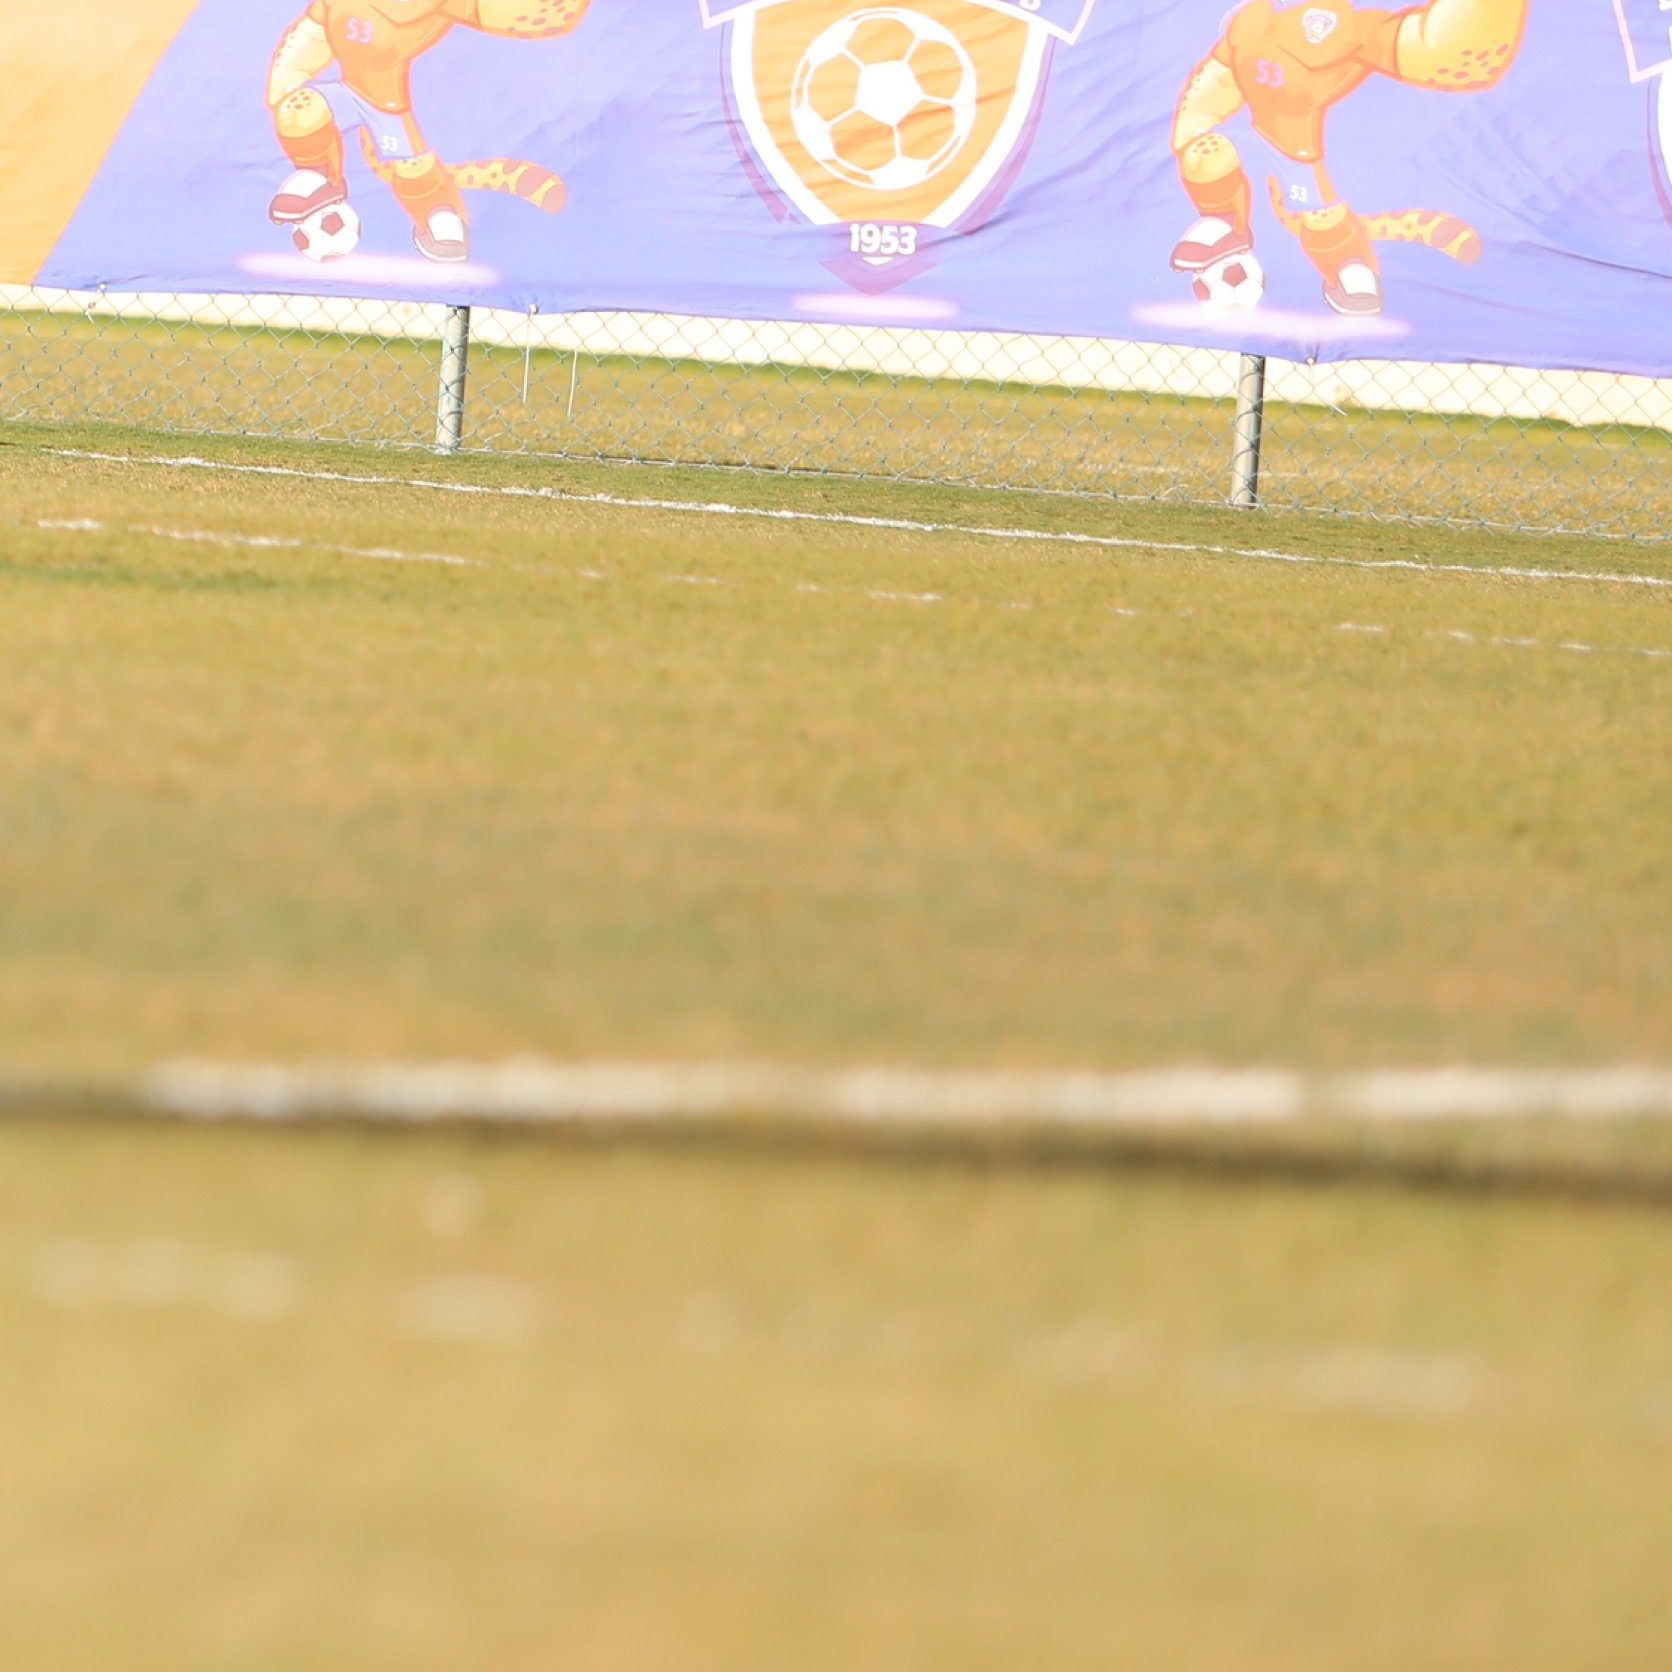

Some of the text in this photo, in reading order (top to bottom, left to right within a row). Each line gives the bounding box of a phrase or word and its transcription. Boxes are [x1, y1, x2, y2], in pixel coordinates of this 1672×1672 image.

[346, 18, 372, 44] 53
[1255, 59, 1284, 87] 53
[382, 136, 398, 151] 53
[1290, 185, 1307, 202] 53
[850, 223, 918, 255] 1953
